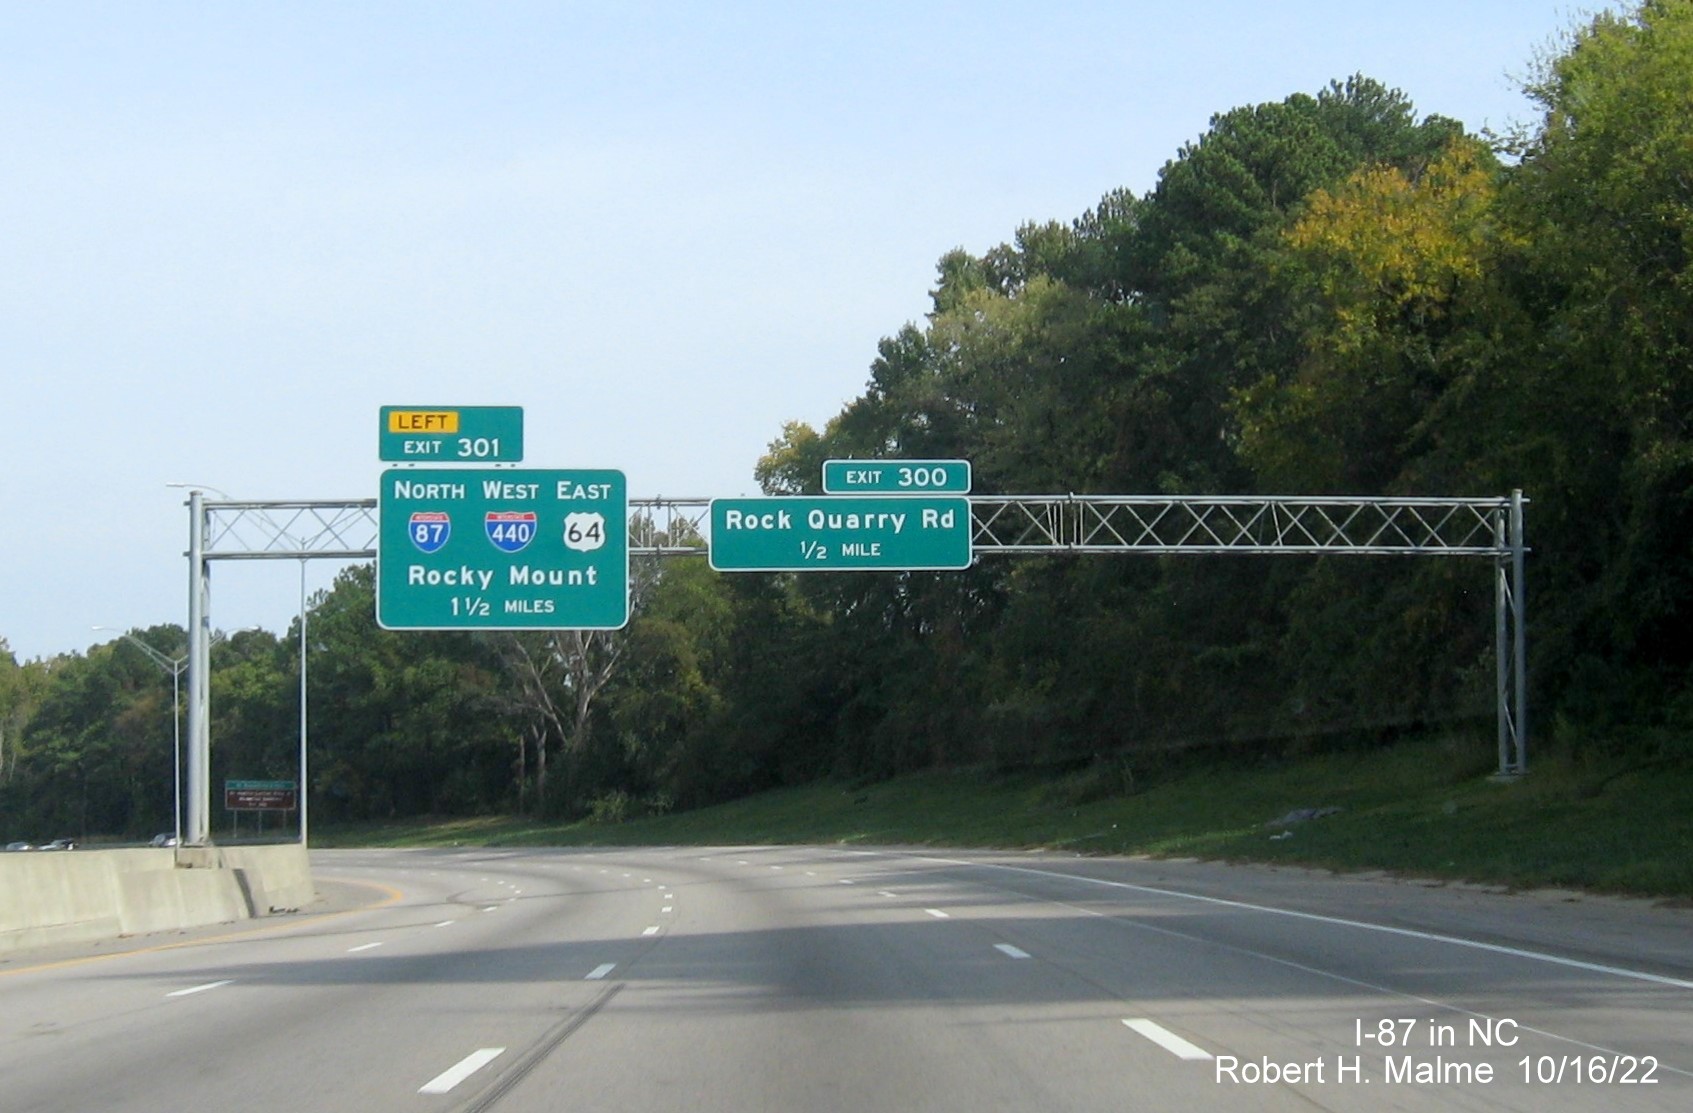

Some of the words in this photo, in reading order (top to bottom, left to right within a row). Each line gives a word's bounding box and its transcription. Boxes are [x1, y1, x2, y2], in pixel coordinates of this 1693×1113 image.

[398, 415, 448, 429] LEFT
[404, 441, 441, 454] EXIT
[457, 438, 499, 457] 301
[846, 470, 882, 484] EXIT
[898, 468, 947, 487] 300
[394, 480, 465, 499] NORTH
[483, 480, 539, 499] WEST
[557, 480, 611, 499] EAST
[726, 509, 792, 530] Rock
[808, 509, 906, 534] Quarry
[922, 508, 955, 529] Rd
[415, 524, 443, 543] 87
[492, 523, 530, 543] 440
[568, 522, 601, 543] 64
[842, 543, 881, 557] MILE
[408, 565, 494, 591] Rocky
[510, 565, 598, 586] Mount
[504, 599, 555, 614] MILES
